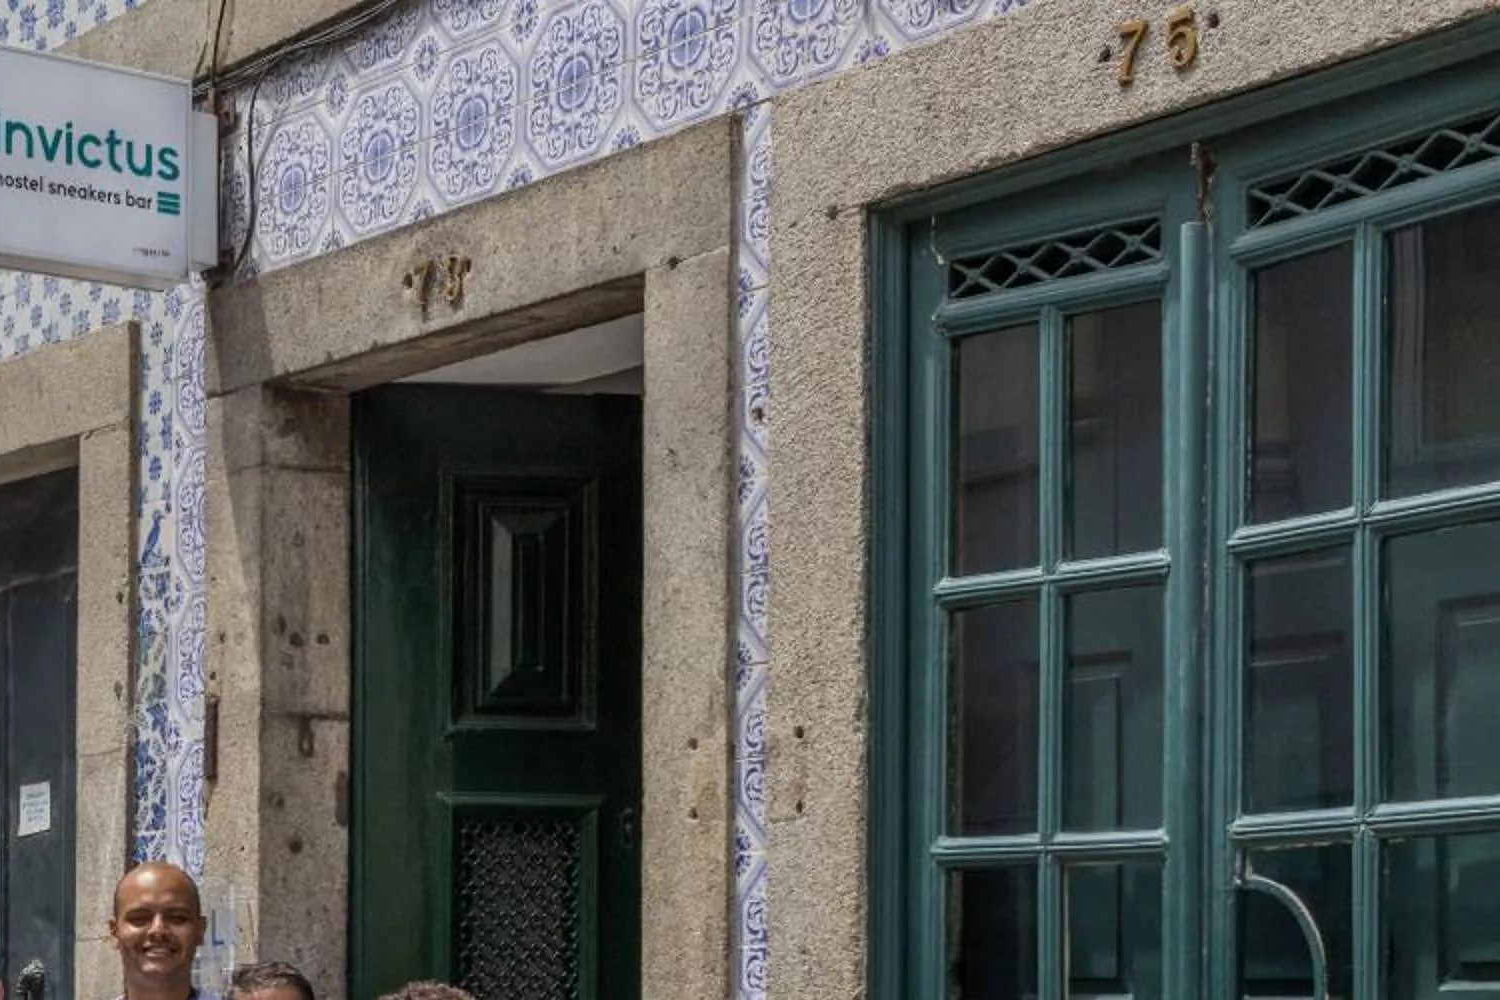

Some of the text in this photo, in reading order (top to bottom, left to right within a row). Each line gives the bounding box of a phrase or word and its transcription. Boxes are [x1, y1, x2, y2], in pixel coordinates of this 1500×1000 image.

[1117, 3, 1198, 87] 75
[47, 180, 122, 206] sneakers
[125, 189, 154, 211] bar
